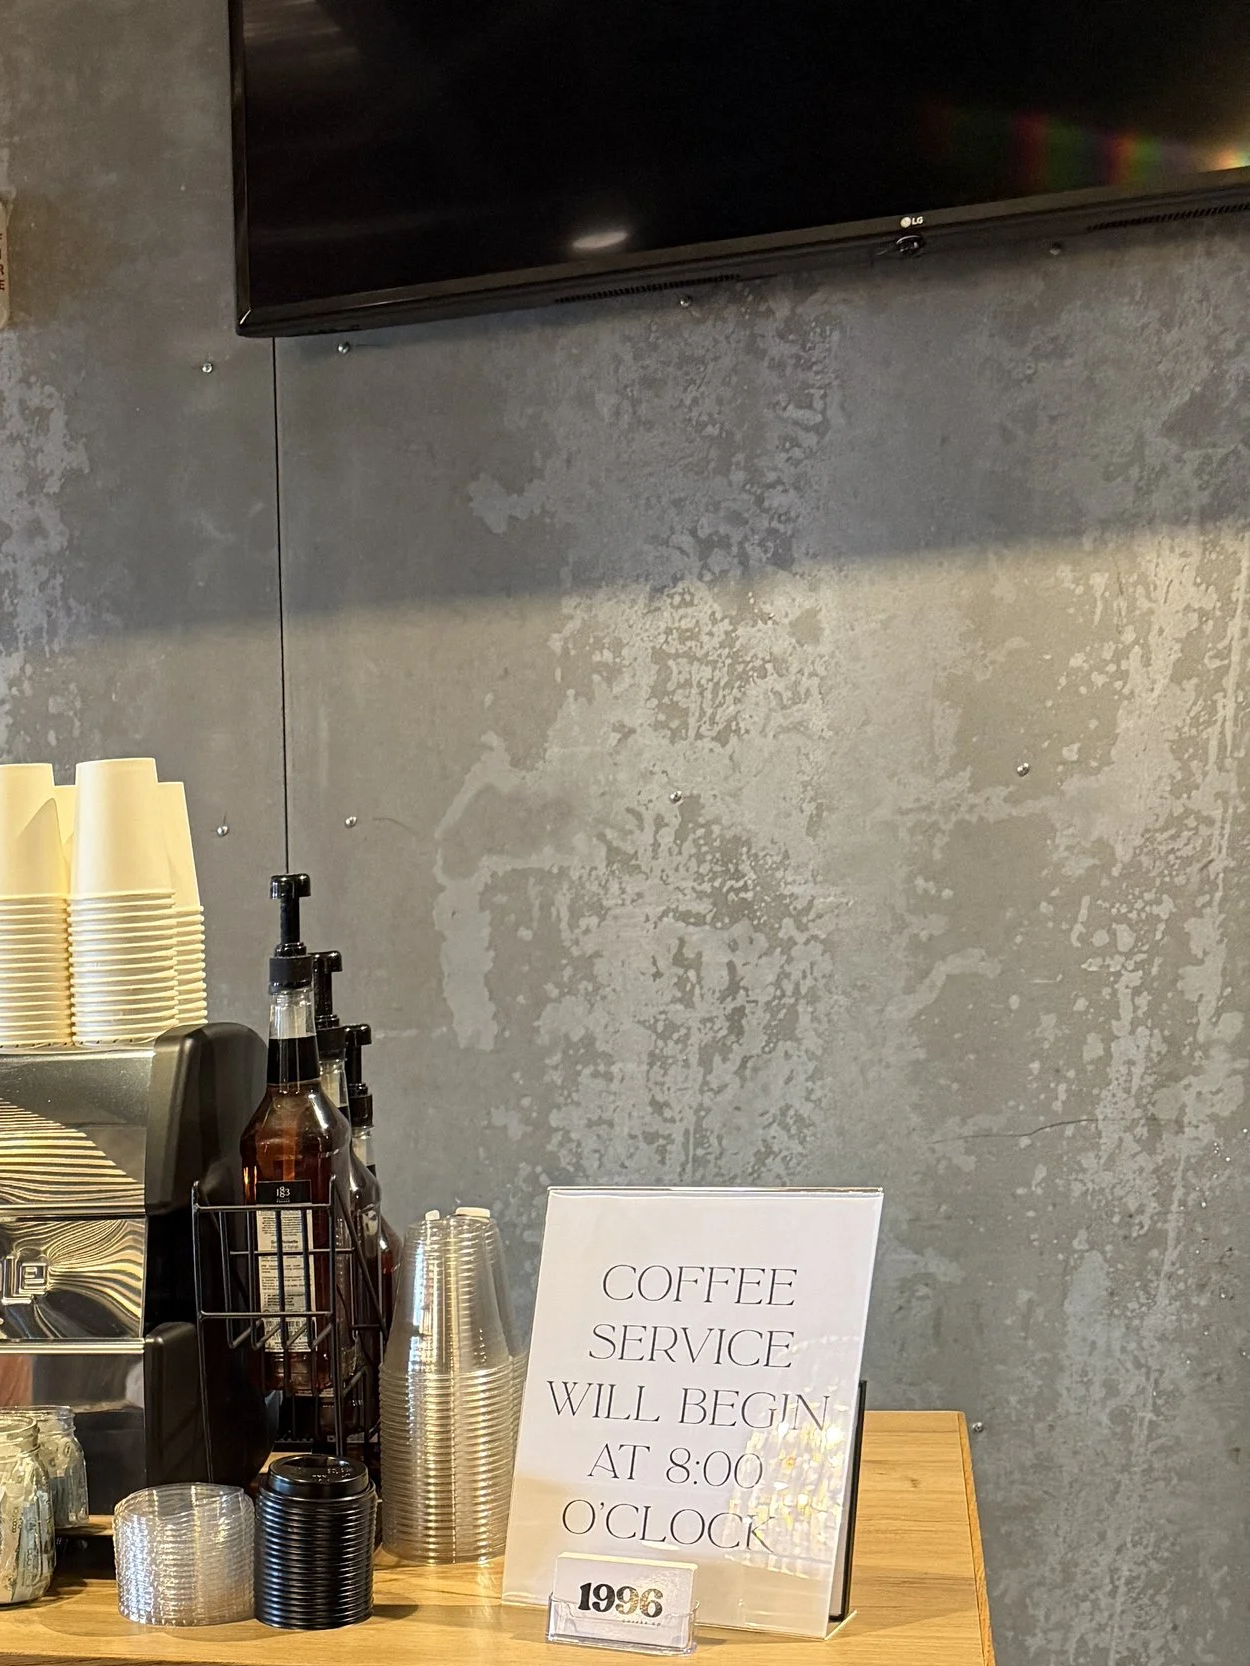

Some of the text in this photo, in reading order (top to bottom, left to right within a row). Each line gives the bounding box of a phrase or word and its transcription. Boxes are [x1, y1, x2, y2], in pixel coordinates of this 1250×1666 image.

[912, 216, 924, 225] LG
[603, 1264, 798, 1306] COFFEE
[588, 1323, 795, 1369] SERVICE
[546, 1380, 831, 1432] WILL BEGIN
[586, 1442, 763, 1490] AT 8:00
[561, 1498, 776, 1553] O'CLOCK
[577, 1582, 664, 1618] 1996
